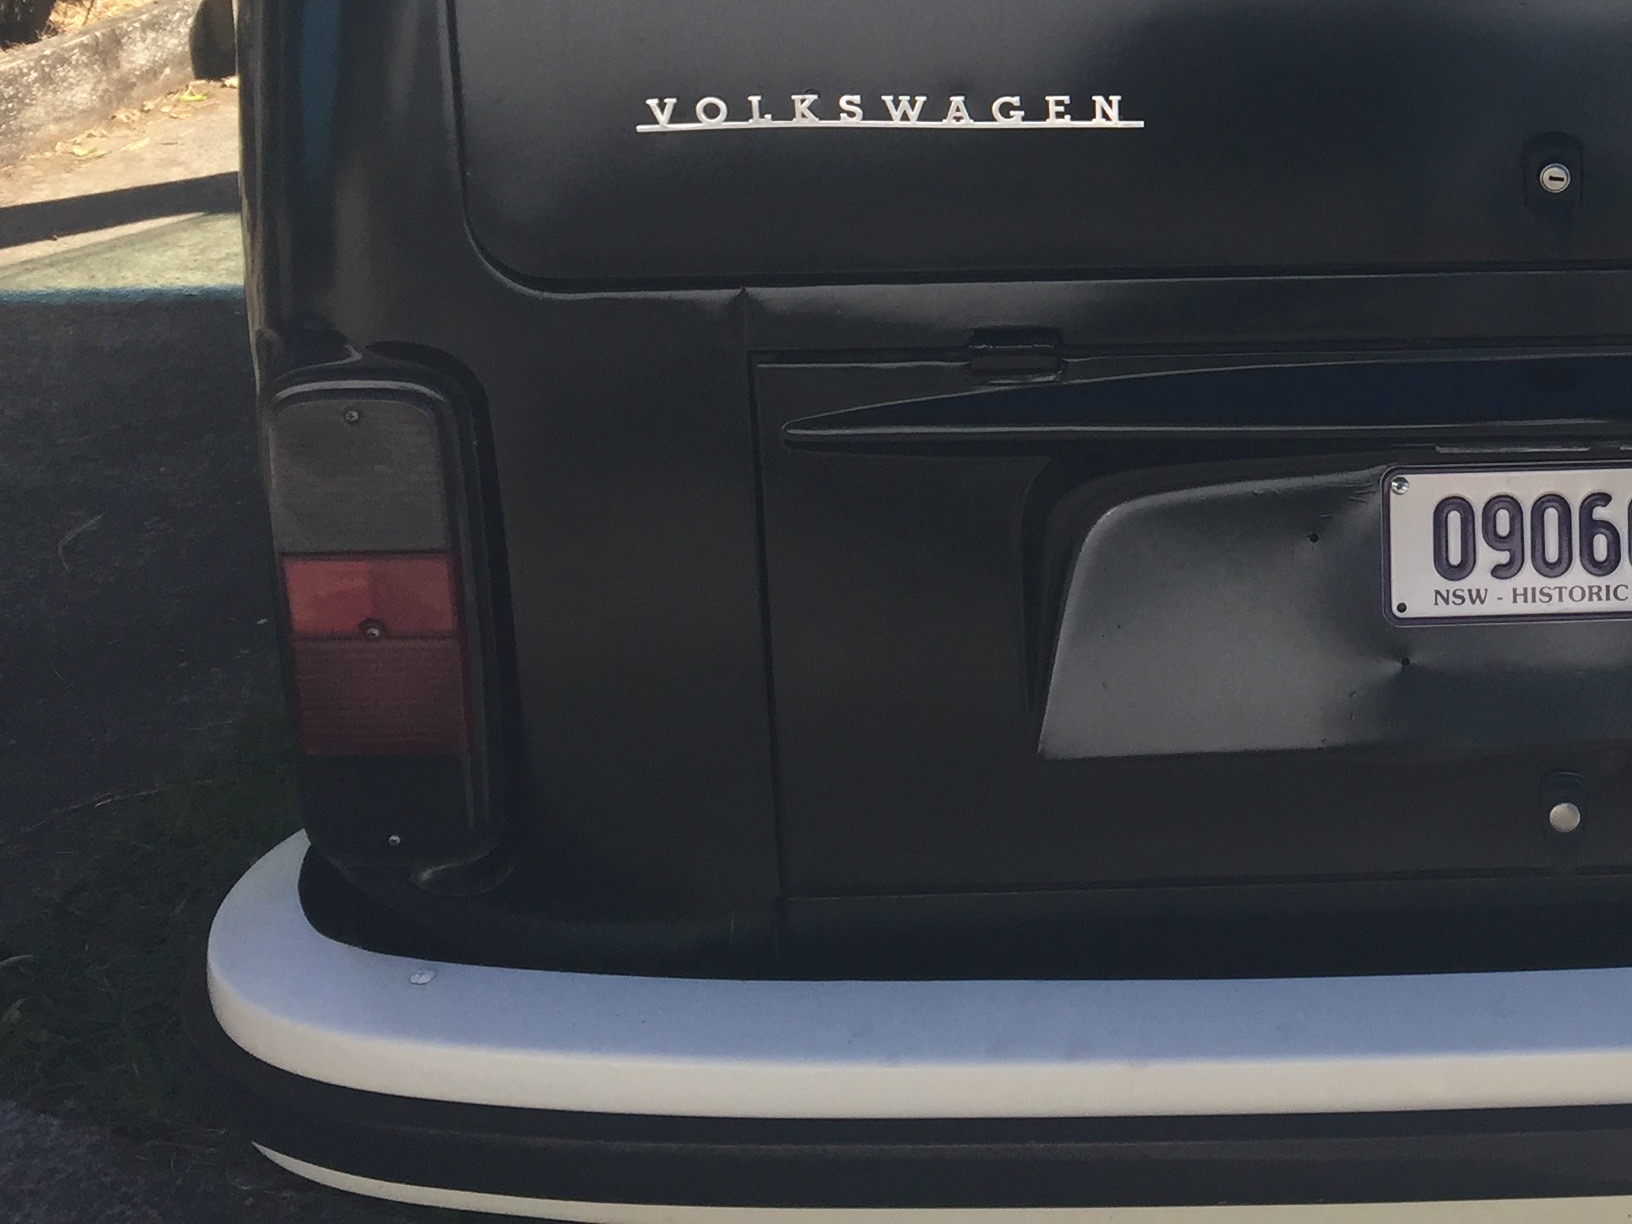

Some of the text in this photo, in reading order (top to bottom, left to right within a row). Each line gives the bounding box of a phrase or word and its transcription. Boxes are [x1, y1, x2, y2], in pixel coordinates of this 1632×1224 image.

[645, 94, 1122, 128] VOLKSWAGEN
[1433, 588, 1488, 606] NSW
[1512, 584, 1629, 604] HISTORIC
